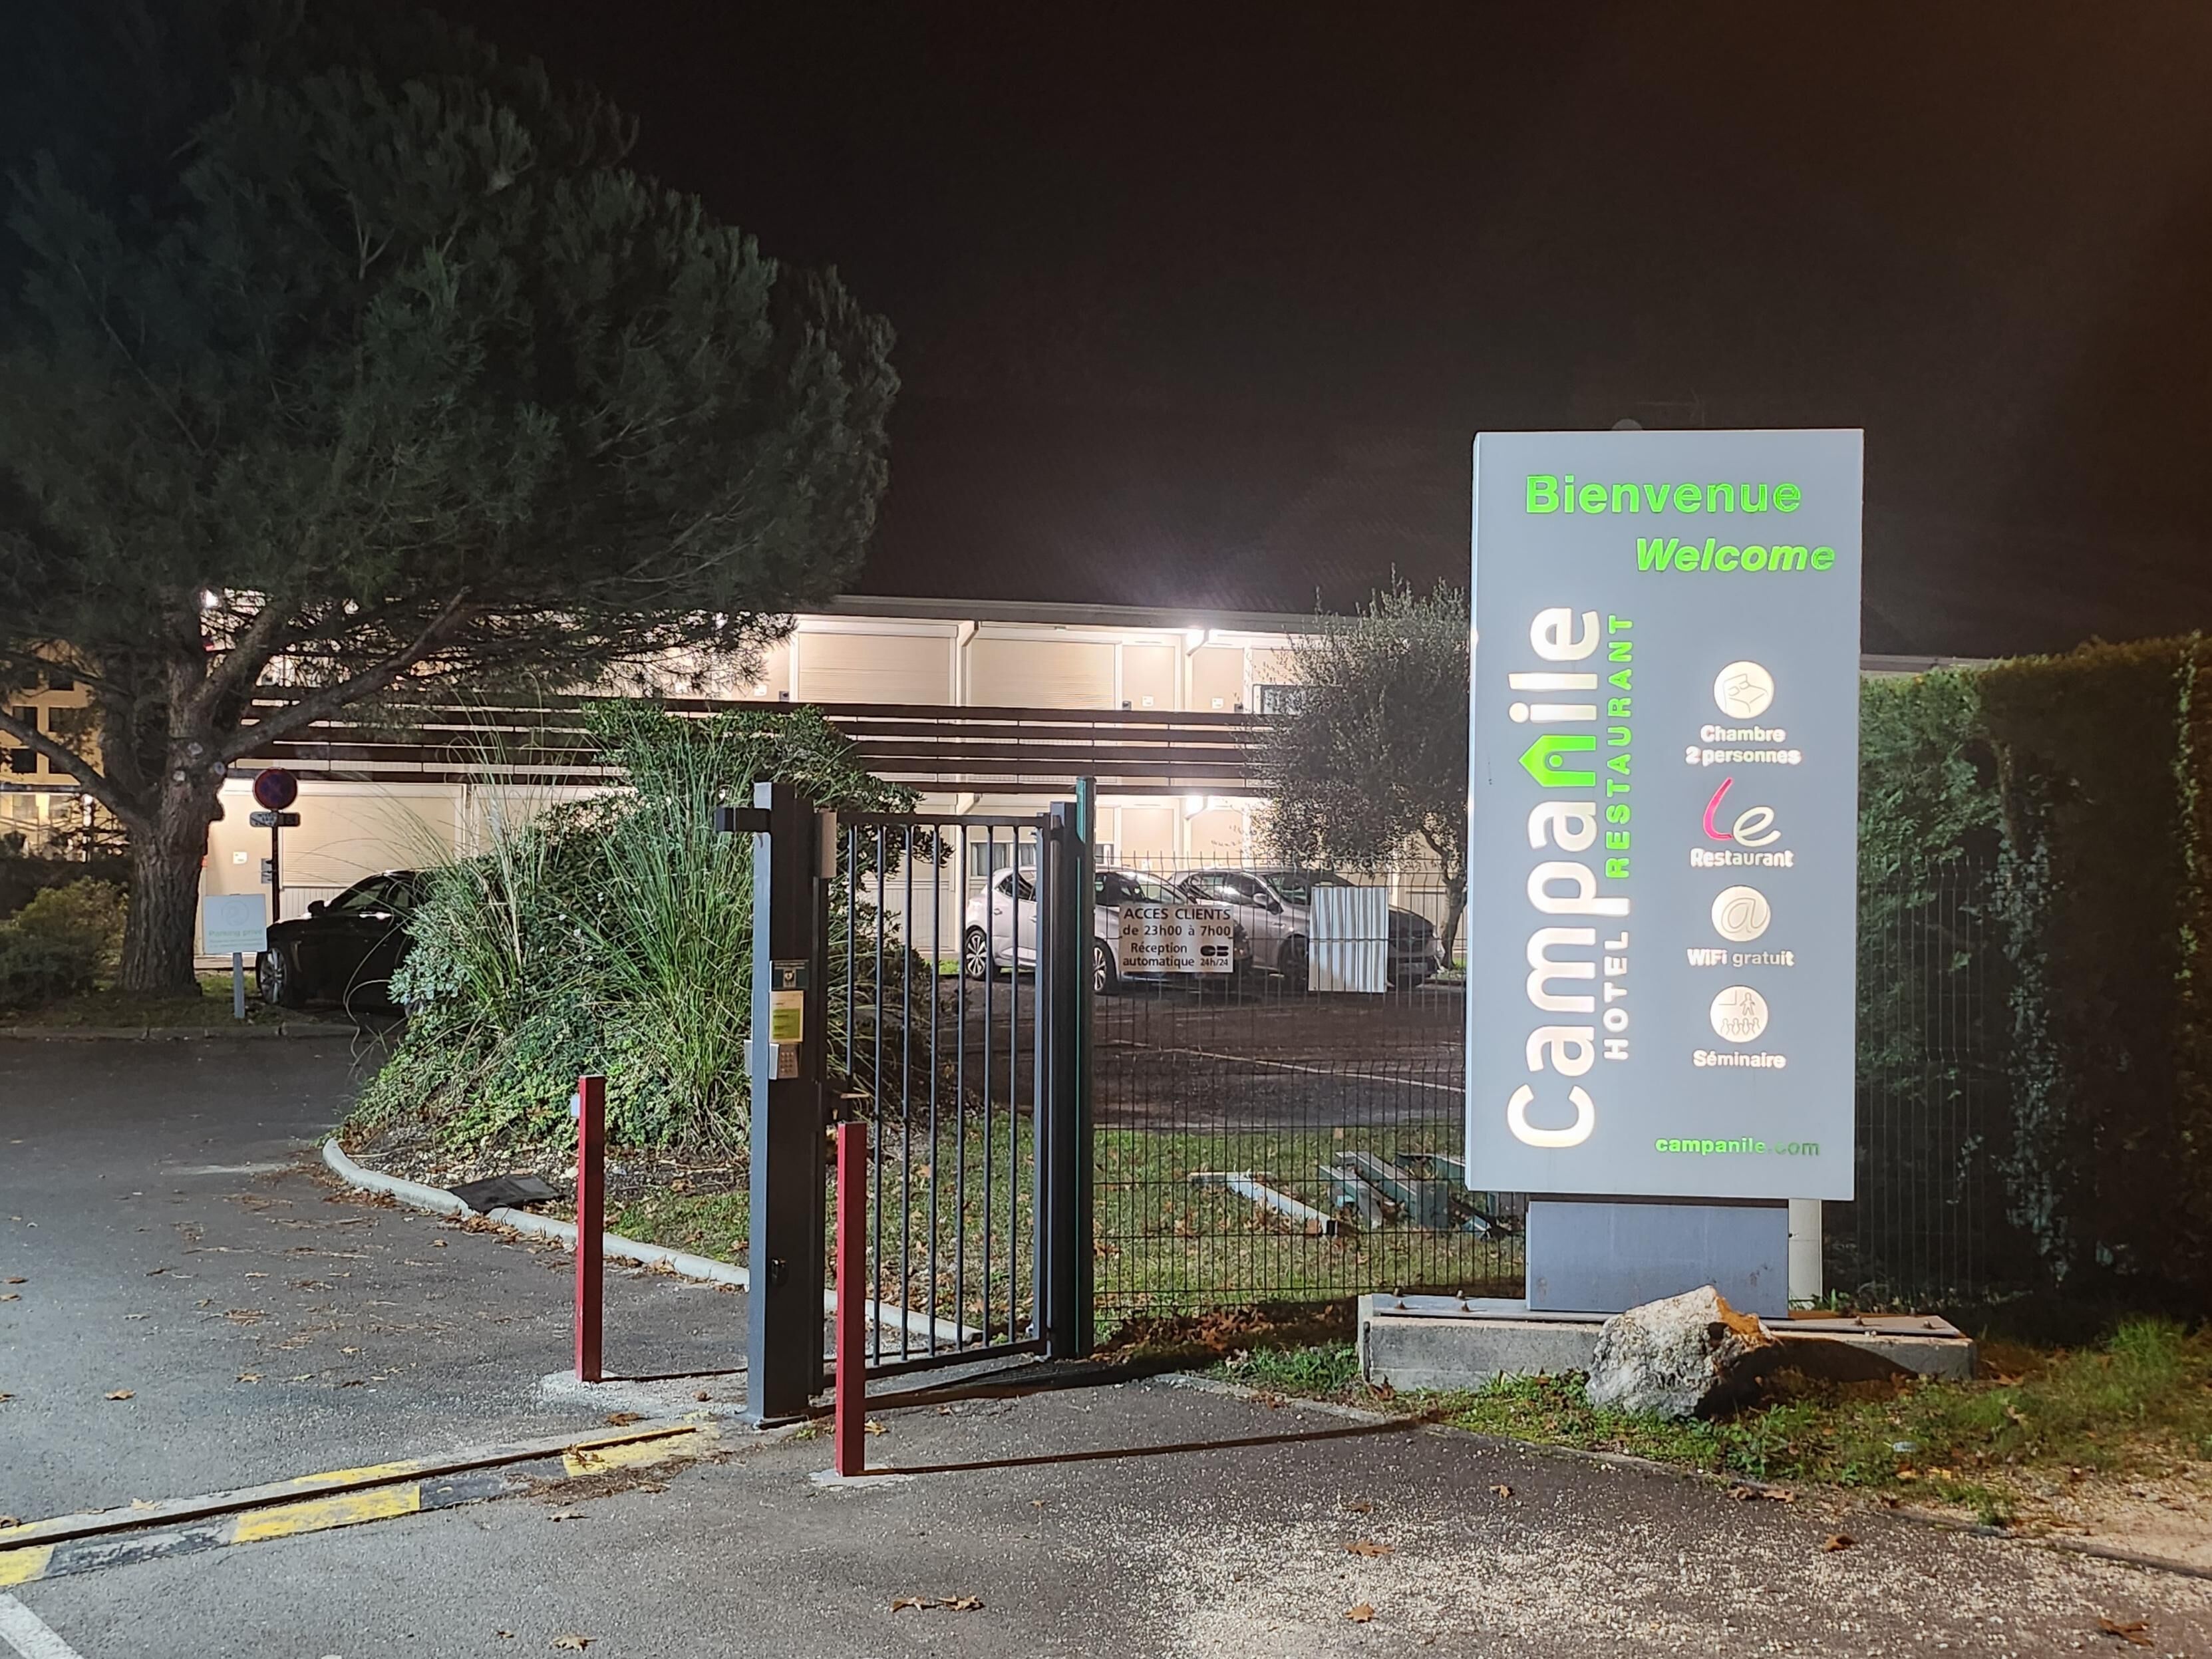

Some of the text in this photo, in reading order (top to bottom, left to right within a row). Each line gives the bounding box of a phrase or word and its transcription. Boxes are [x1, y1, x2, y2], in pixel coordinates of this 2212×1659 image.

[1525, 475, 1802, 514] Bienvenue
[1637, 537, 1835, 571] Welcome
[1700, 724, 1786, 742] Chambre
[1605, 614, 1633, 878] RESTAURANT
[1685, 746, 1802, 767] 2 personnes
[1690, 847, 1794, 867] Restaurant
[1123, 908, 1231, 920] ACCES CLIENTS
[1122, 925, 1231, 937] de 23h00 à 7h00
[1131, 942, 1187, 955] Réception
[1123, 956, 1195, 968] automatique
[1732, 951, 1795, 967] gratuit
[1603, 931, 1630, 1060] HOTEL
[1693, 1049, 1787, 1068] Séminaire
[1655, 1137, 1821, 1156] campanile.com
